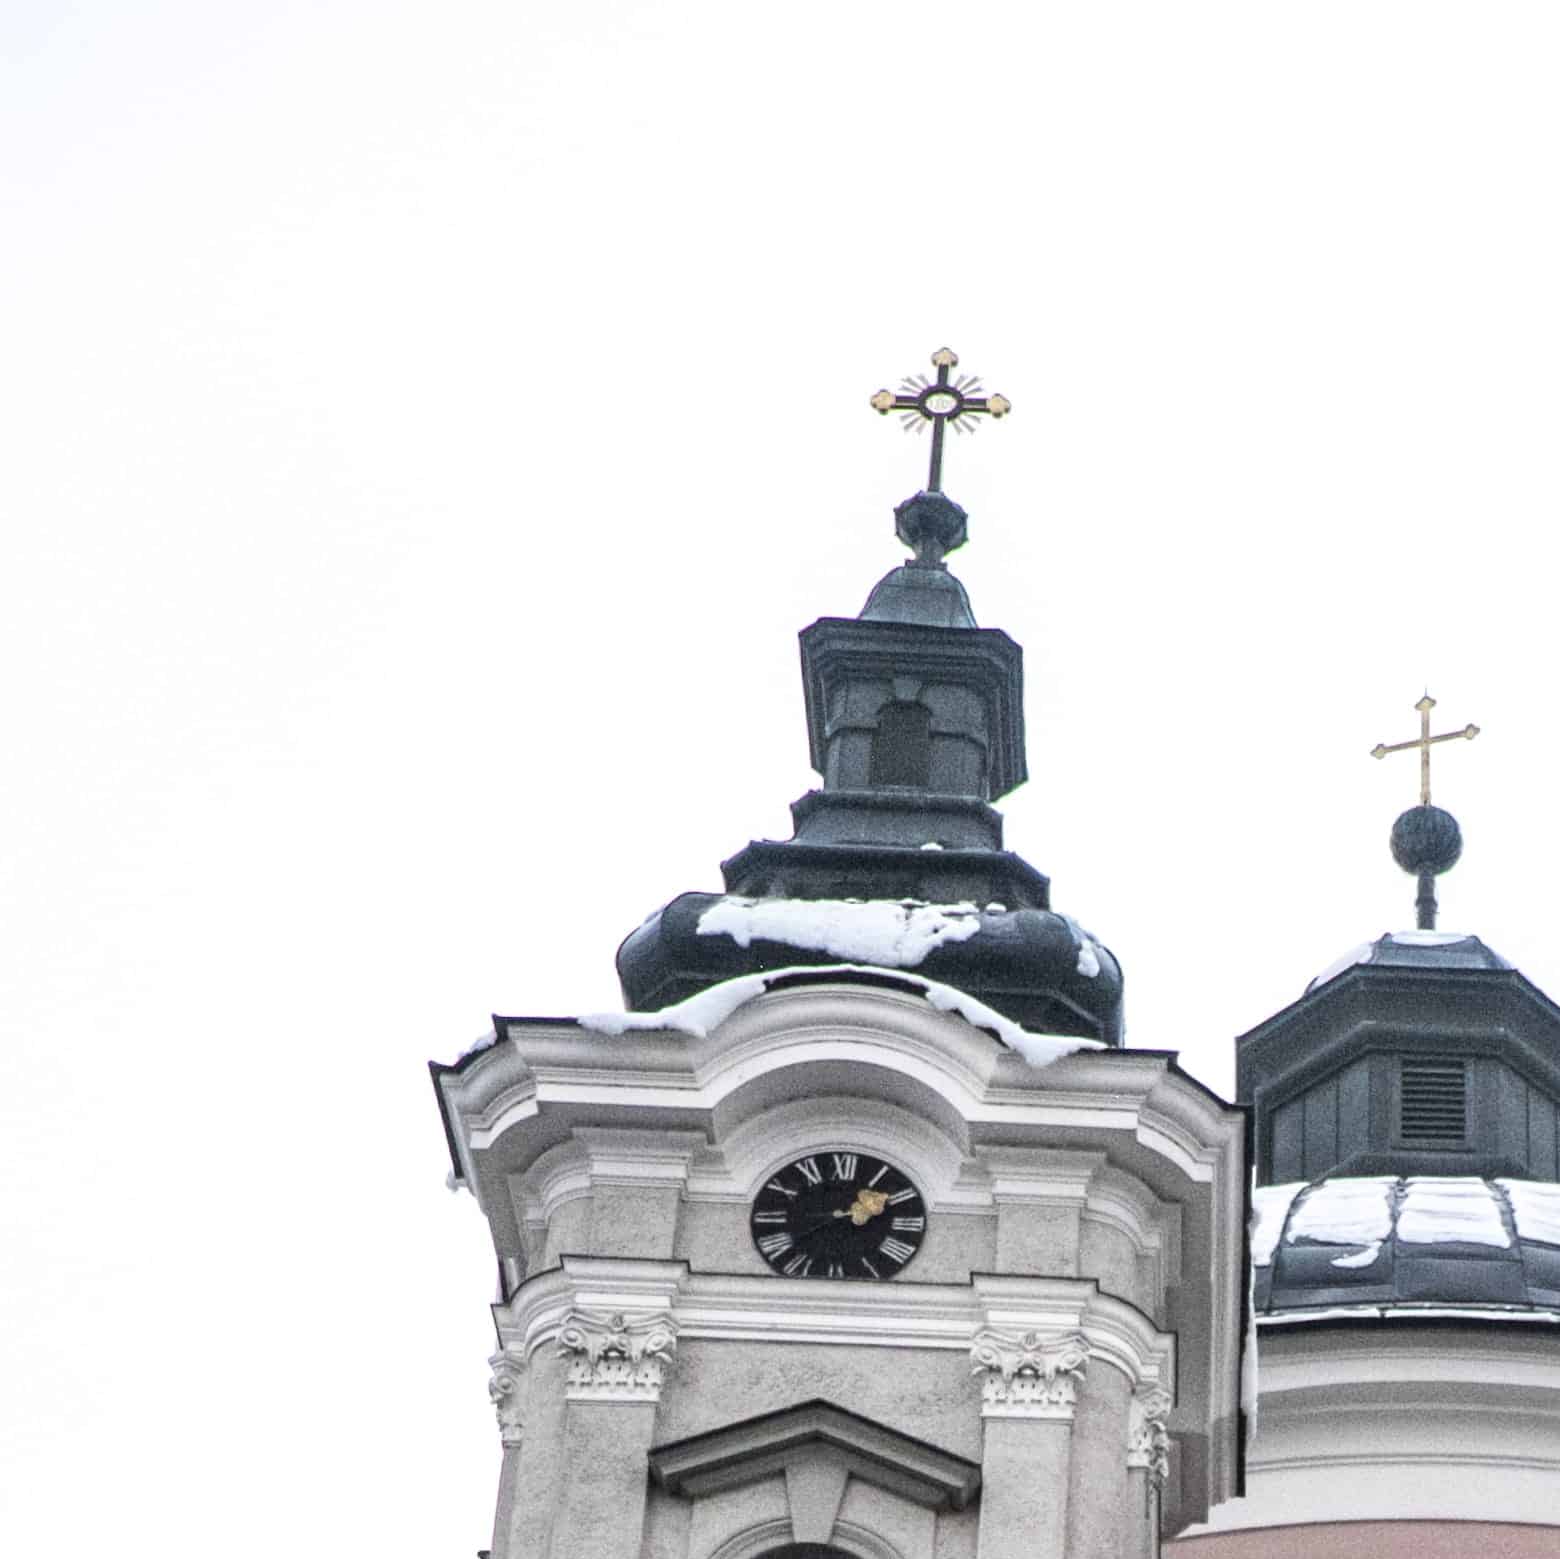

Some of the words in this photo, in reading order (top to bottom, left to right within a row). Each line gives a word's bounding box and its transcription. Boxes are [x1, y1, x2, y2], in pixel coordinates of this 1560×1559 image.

[795, 1157, 823, 1187] XI
[829, 1154, 858, 1181] XII
[891, 1216, 925, 1232] III
